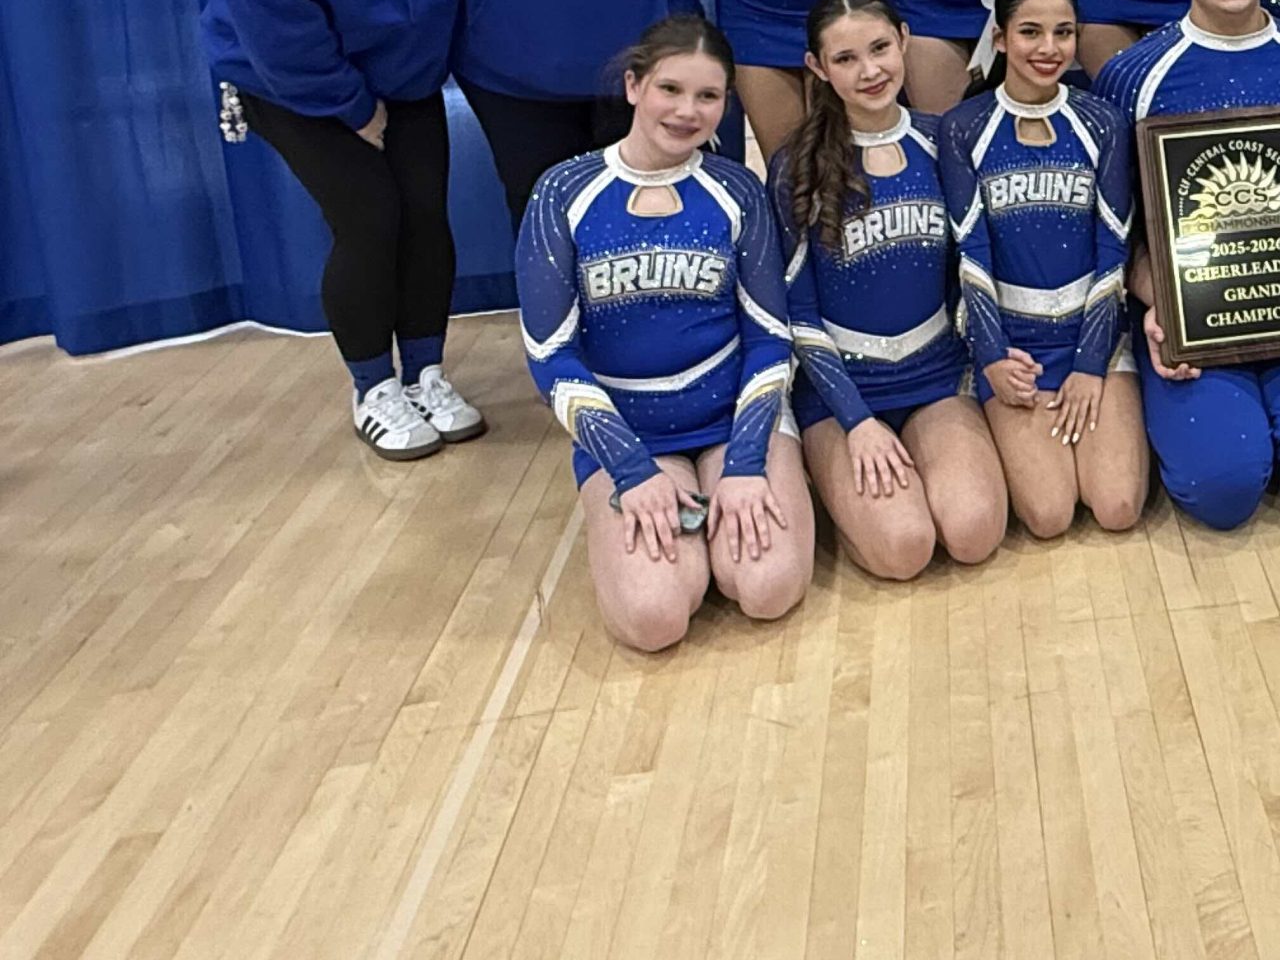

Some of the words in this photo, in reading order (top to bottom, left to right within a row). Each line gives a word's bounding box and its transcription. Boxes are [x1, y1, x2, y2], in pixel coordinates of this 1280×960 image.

[1228, 140, 1264, 153] COAST
[989, 172, 1091, 211] BRUINS
[1215, 188, 1269, 207] CCS
[845, 205, 945, 255] BRUINS
[586, 250, 725, 300] BRUINS
